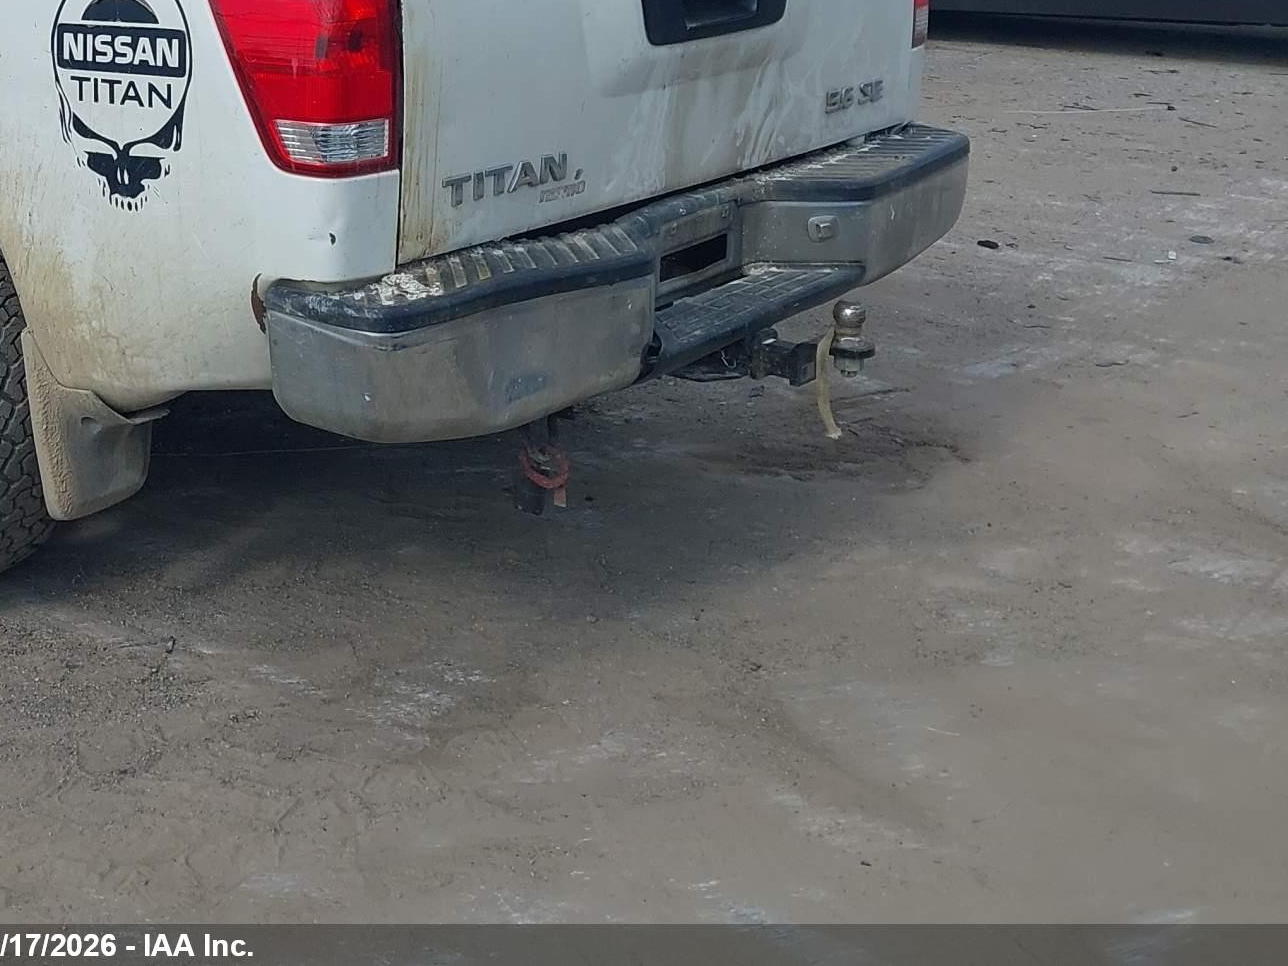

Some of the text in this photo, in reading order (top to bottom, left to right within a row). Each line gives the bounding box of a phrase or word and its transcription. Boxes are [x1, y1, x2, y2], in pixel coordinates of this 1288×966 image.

[63, 32, 179, 67] NISSAN
[70, 76, 172, 109] TITAN
[441, 151, 568, 208] TITAN
